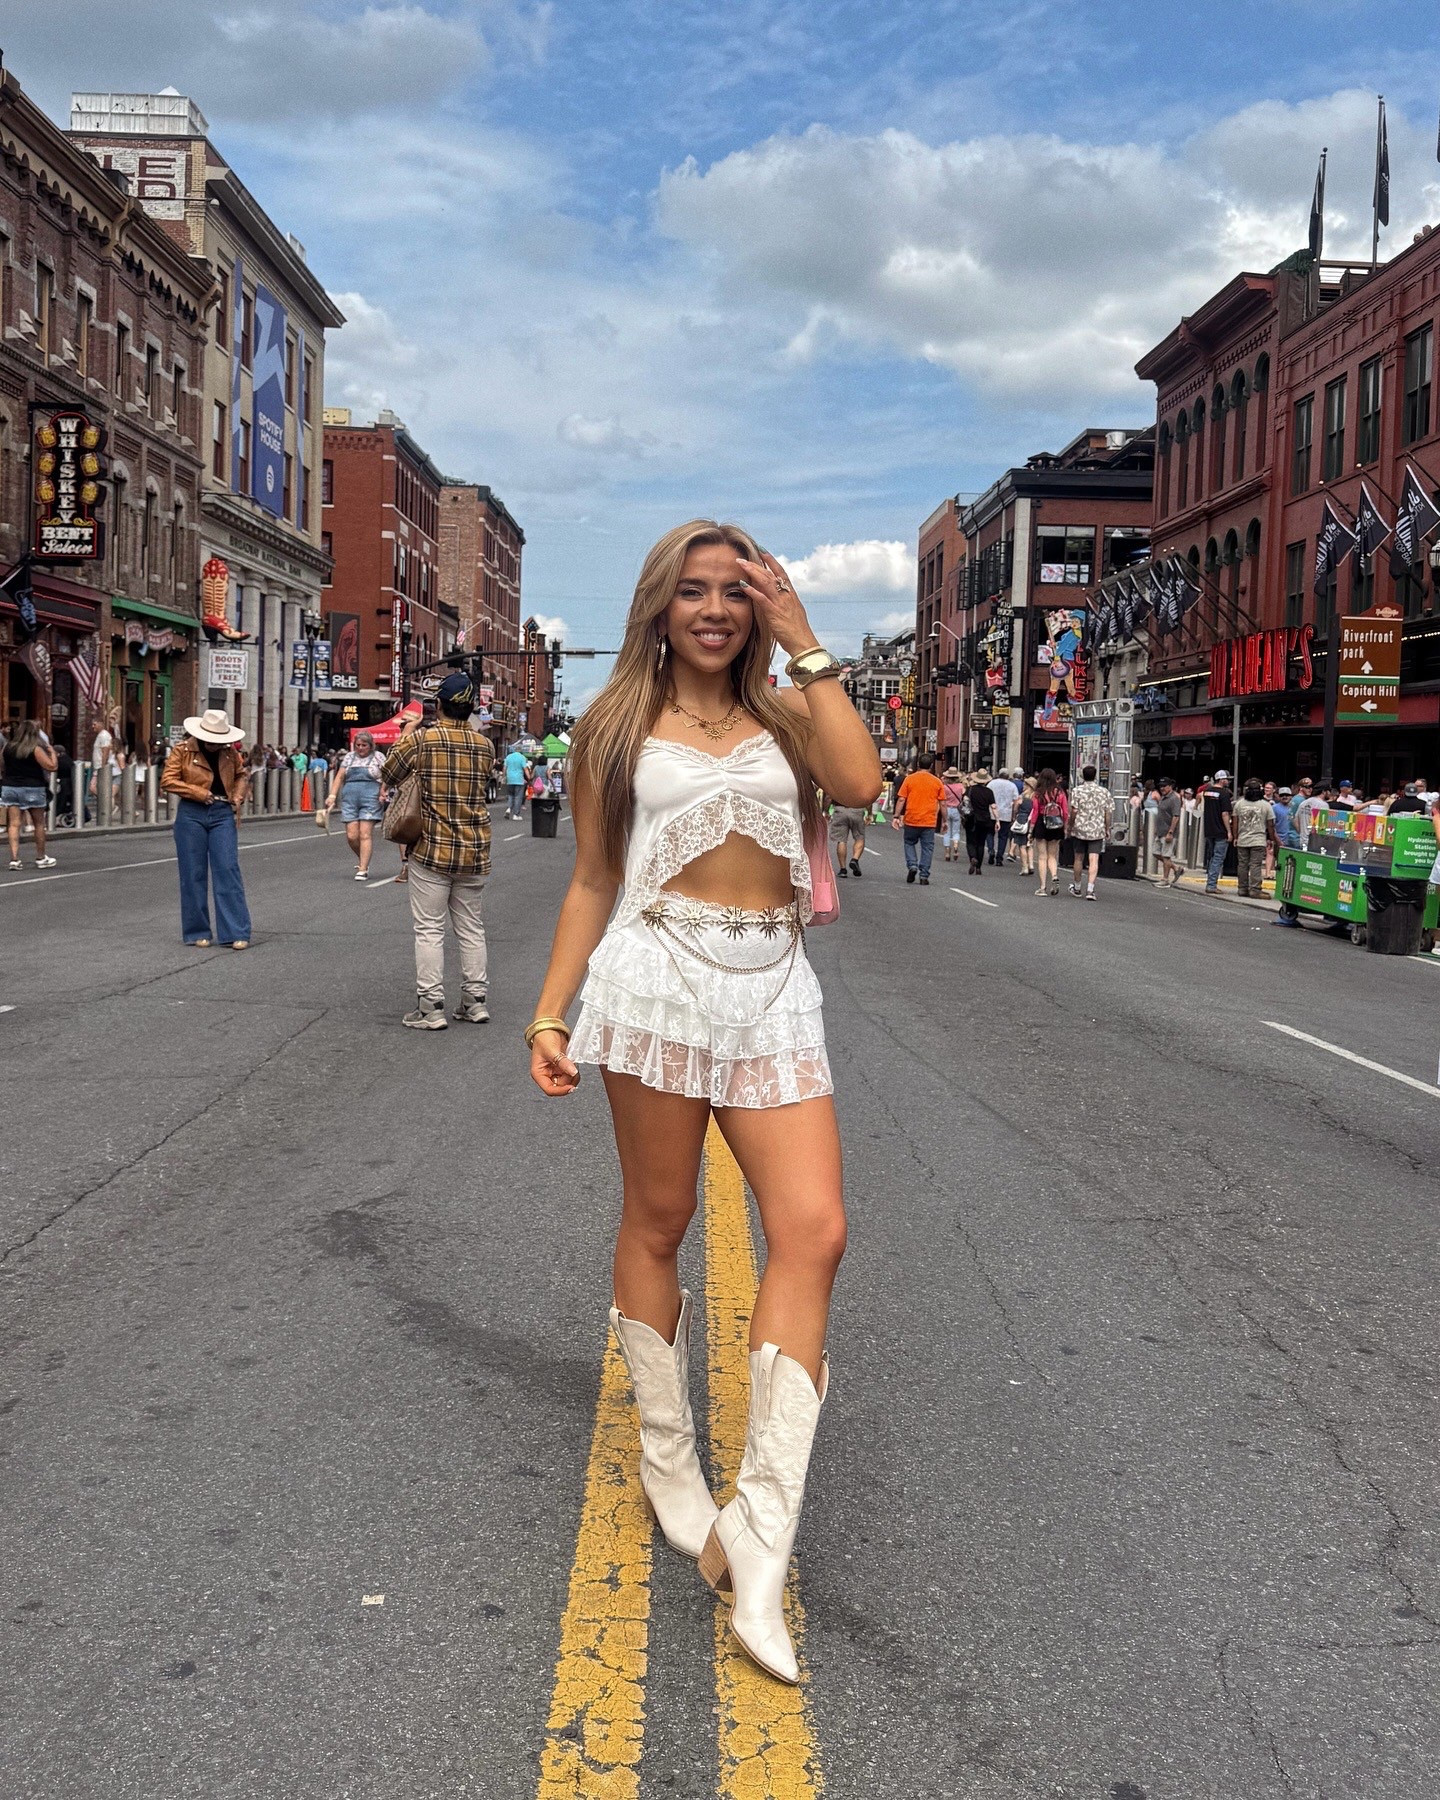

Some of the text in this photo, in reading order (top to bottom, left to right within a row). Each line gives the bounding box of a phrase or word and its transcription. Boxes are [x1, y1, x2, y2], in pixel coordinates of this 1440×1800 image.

[258, 411, 283, 440] SPOTIFY
[260, 429, 281, 455] HOUSE
[57, 418, 80, 524] WHISKEY
[41, 526, 93, 540] BENT
[1343, 629, 1394, 643] Riverfront
[215, 655, 242, 664] BOOTS
[1342, 646, 1365, 661] park
[528, 630, 537, 698] CHIEFS
[332, 674, 358, 682] OLE
[332, 680, 358, 689] RED
[1342, 684, 1397, 698] Capitol Hill
[343, 705, 358, 713] ONE
[342, 713, 359, 721] LOVE
[1407, 836, 1437, 844] Hydration
[1403, 849, 1428, 858] brought
